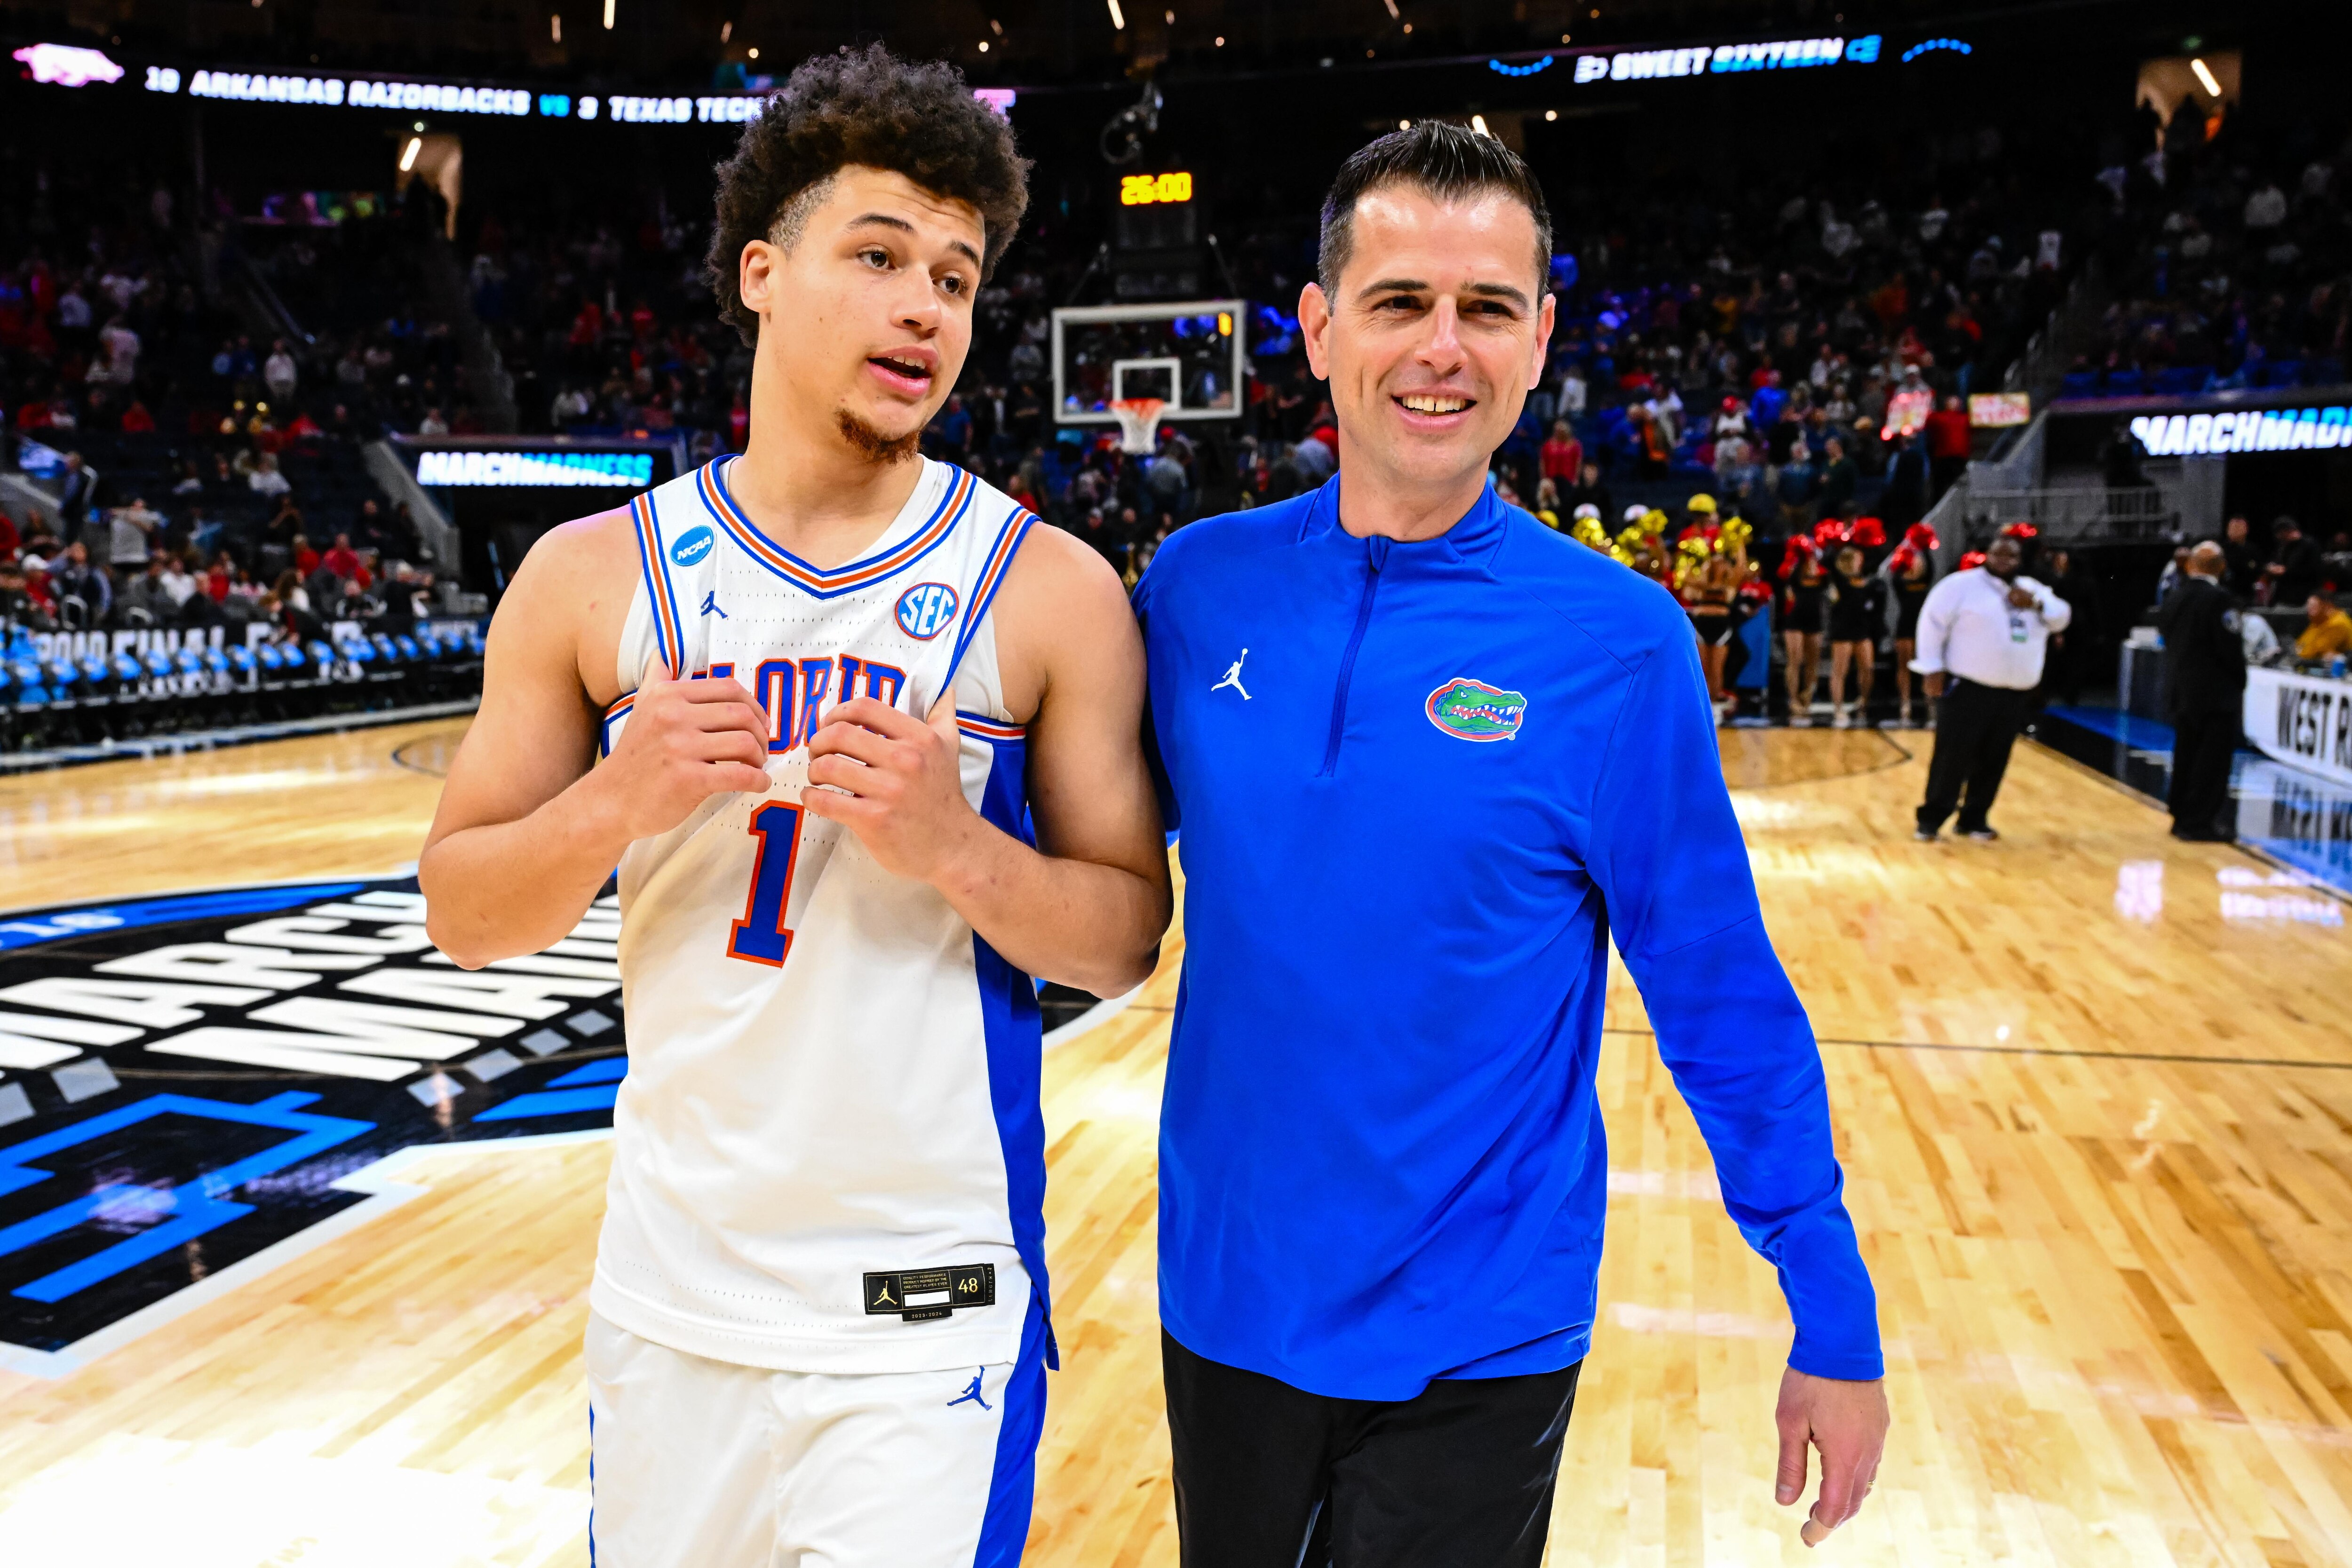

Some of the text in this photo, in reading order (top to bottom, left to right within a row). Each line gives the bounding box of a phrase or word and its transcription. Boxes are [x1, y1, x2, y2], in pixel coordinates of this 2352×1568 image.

[1610, 37, 1844, 80] SWEET SIXTEEN
[189, 70, 345, 105] ARKANSAS
[348, 80, 531, 116] RAZORBACKS
[539, 95, 570, 117] VS
[609, 96, 692, 123] TEXAS
[677, 535, 712, 561] NCAA
[901, 586, 954, 635] SEC
[2278, 686, 2332, 761] WEST
[727, 800, 805, 968] 1
[958, 1278, 978, 1294] 48
